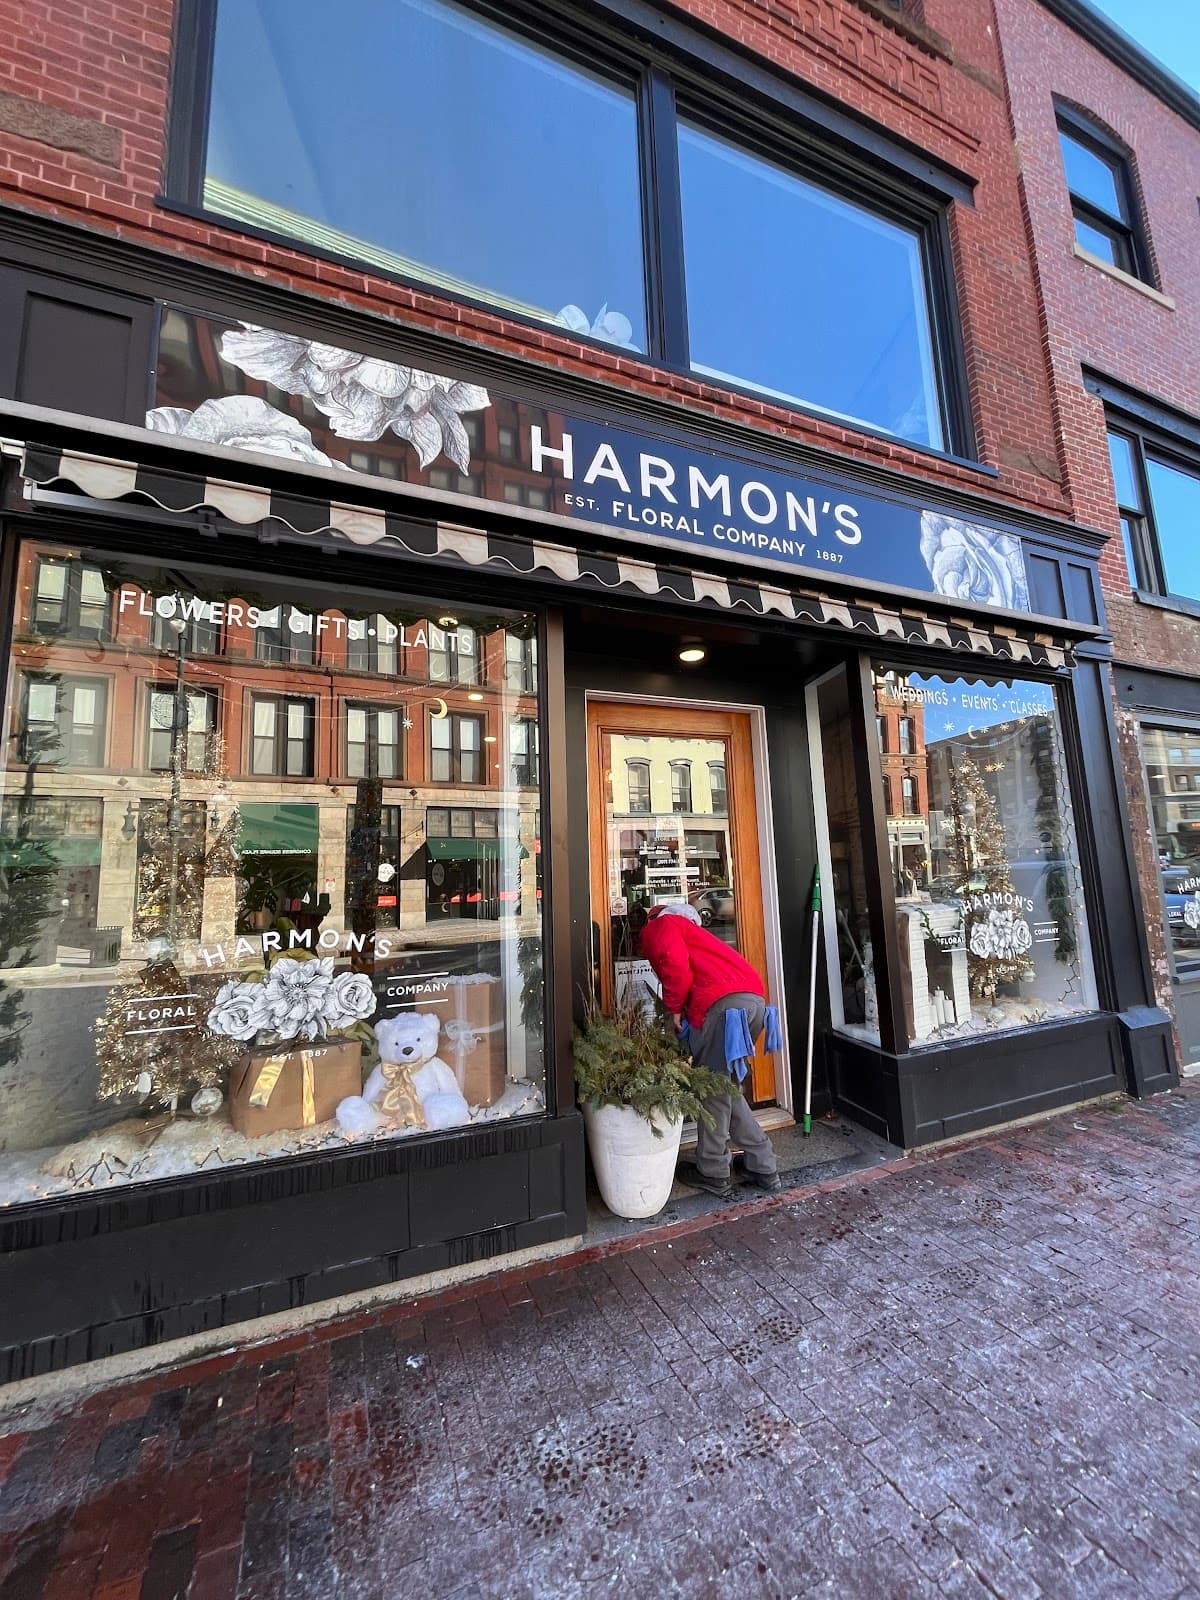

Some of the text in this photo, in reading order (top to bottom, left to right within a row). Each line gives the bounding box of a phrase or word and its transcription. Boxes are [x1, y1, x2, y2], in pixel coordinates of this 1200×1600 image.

[530, 424, 863, 546] HARMON'S
[563, 494, 844, 564] EST. FLORAL COMPANY 1887
[118, 590, 473, 654] FLOWERS GIFTS PLANTS
[890, 685, 1049, 718] WEDDINGS EVENTS CLASSES
[961, 891, 1034, 915] HARMON'S
[940, 936, 965, 945] FLORAL
[1034, 927, 1059, 936] COMPANY
[201, 928, 393, 968] HARMON'S
[387, 981, 450, 997] COMPANY
[126, 1004, 197, 1022] FLORAL
